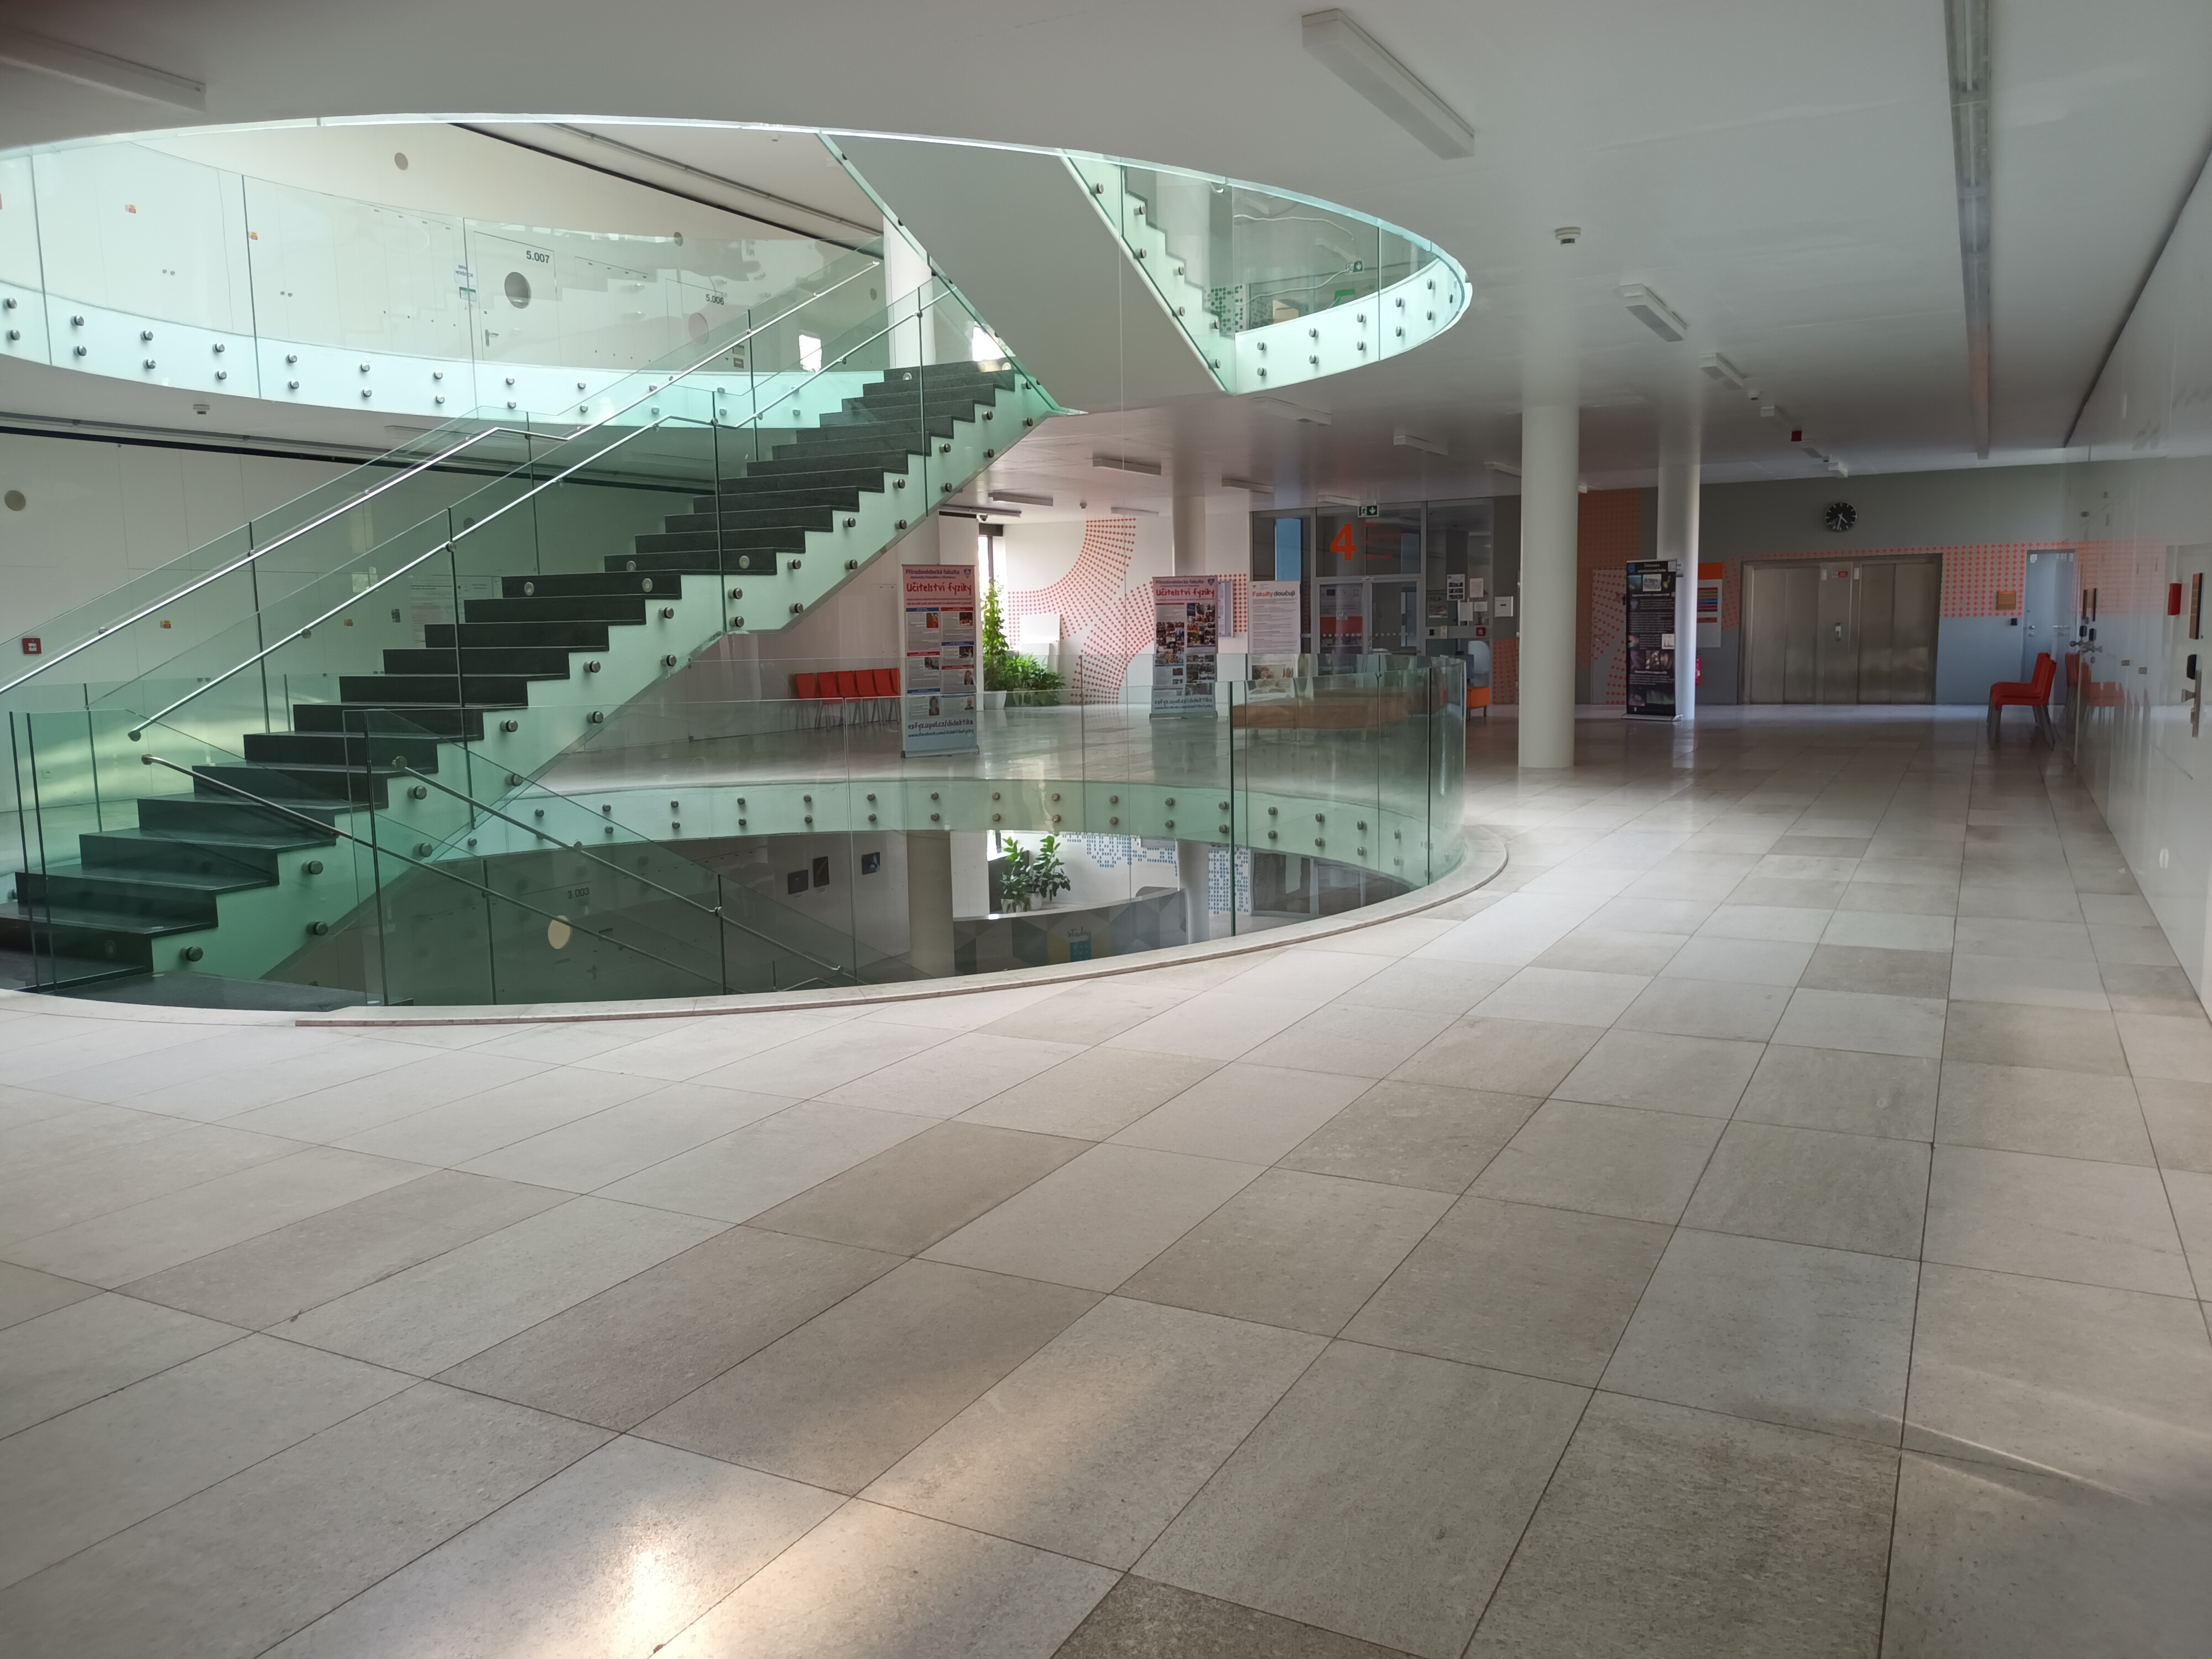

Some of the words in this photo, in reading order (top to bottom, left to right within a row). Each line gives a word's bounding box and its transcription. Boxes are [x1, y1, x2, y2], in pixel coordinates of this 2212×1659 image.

[526, 250, 550, 264] 5.007
[706, 294, 724, 305] 5.006
[1329, 523, 1357, 561] 4
[906, 582, 945, 592] Učitelství
[948, 582, 972, 596] fyziky
[1156, 588, 1191, 596] Učitelství
[1193, 588, 1215, 598] fyziky
